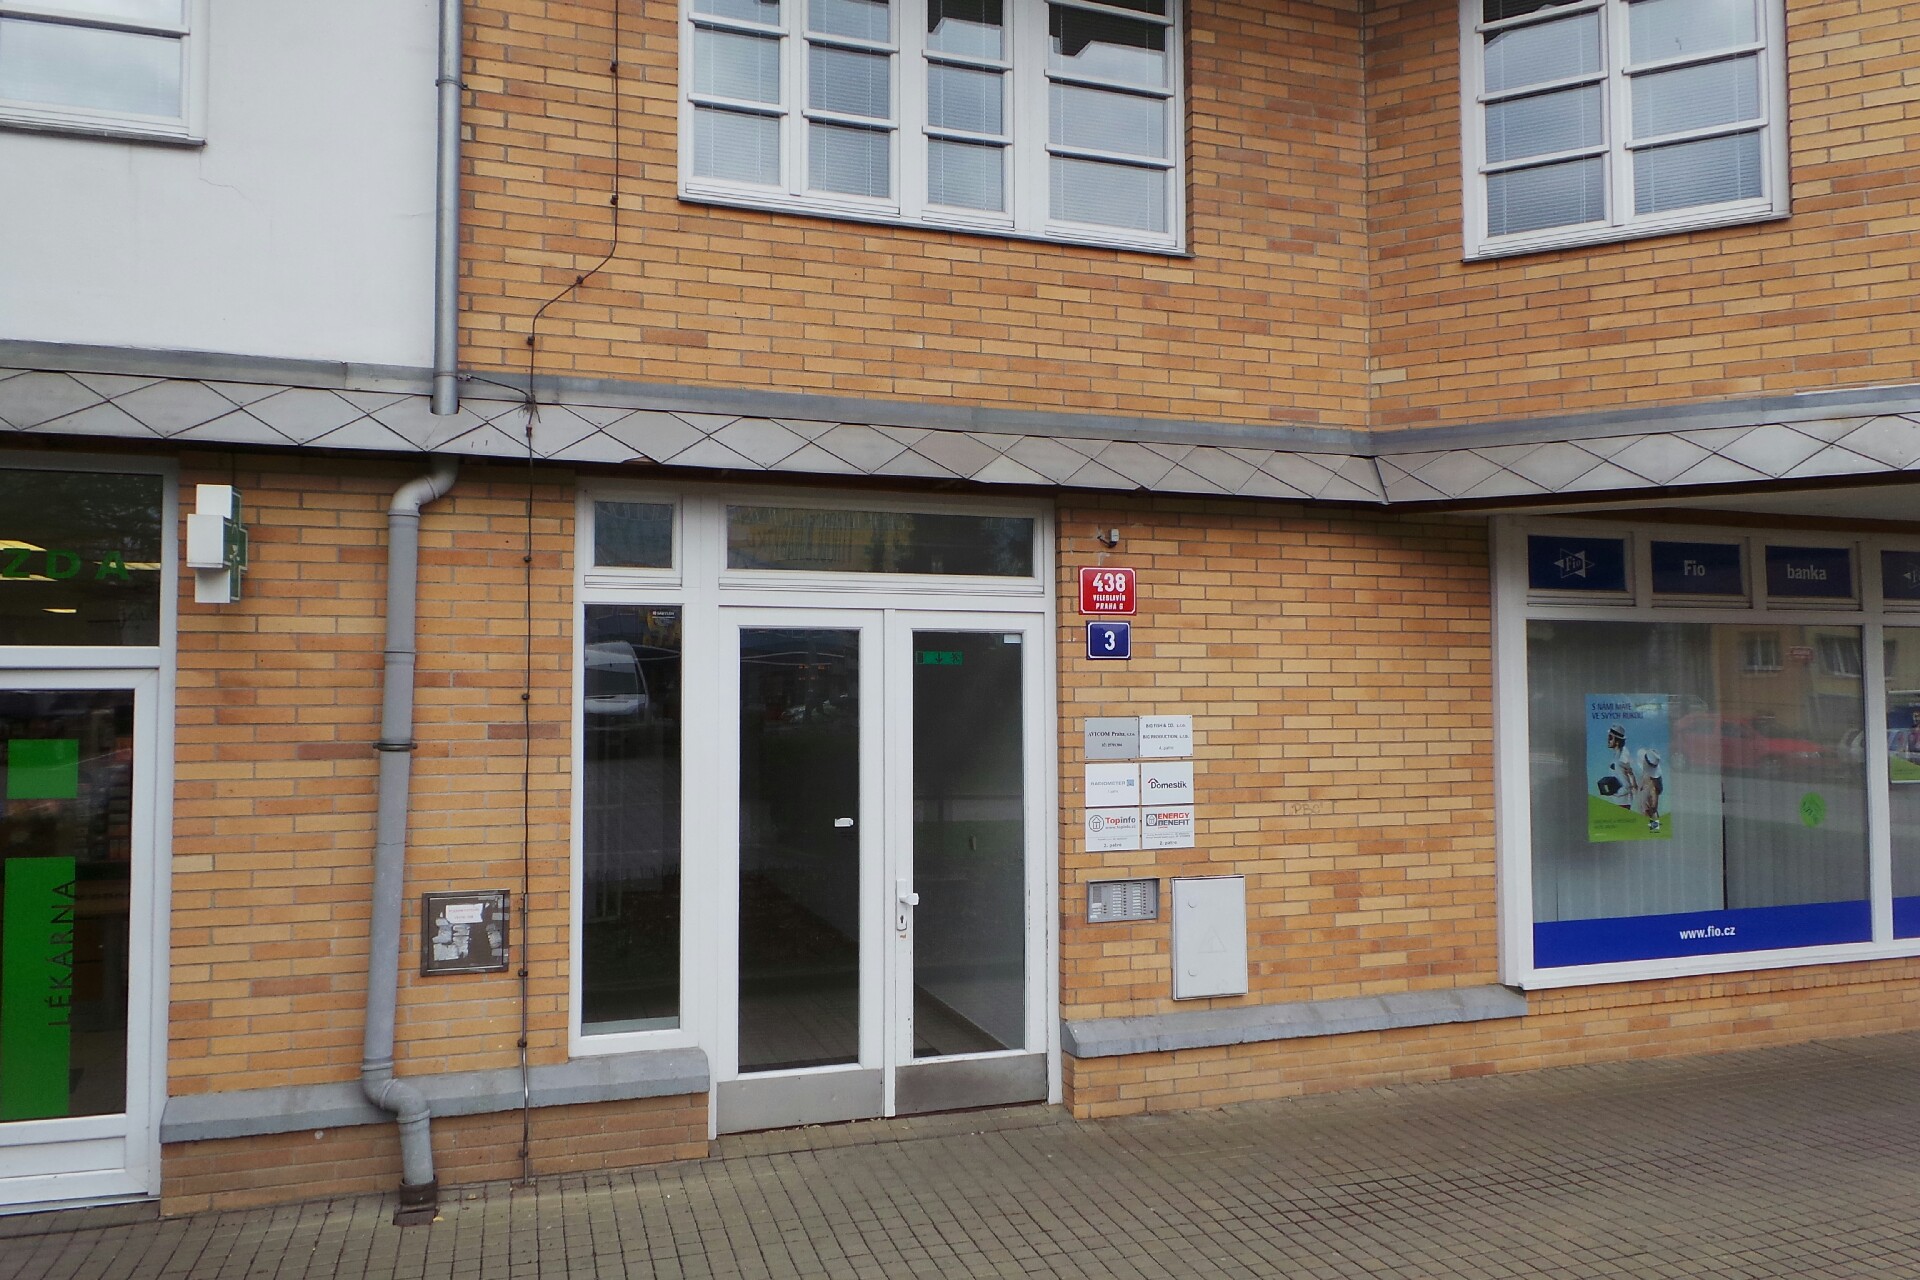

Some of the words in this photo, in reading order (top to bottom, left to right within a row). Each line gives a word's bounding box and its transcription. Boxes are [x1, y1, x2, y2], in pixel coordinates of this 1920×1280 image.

[1683, 559, 1706, 577] Fio
[1786, 564, 1827, 581] banka
[1093, 572, 1126, 592] 438
[1105, 630, 1115, 651] 3
[1150, 780, 1187, 790] Domestik
[1105, 816, 1136, 826] Topinfo
[1157, 812, 1190, 820] ENERGY
[1157, 818, 1190, 827] BENEFIT
[1679, 925, 1736, 940] www.fio.cz
[44, 880, 77, 1026] LÉKÁRNA
